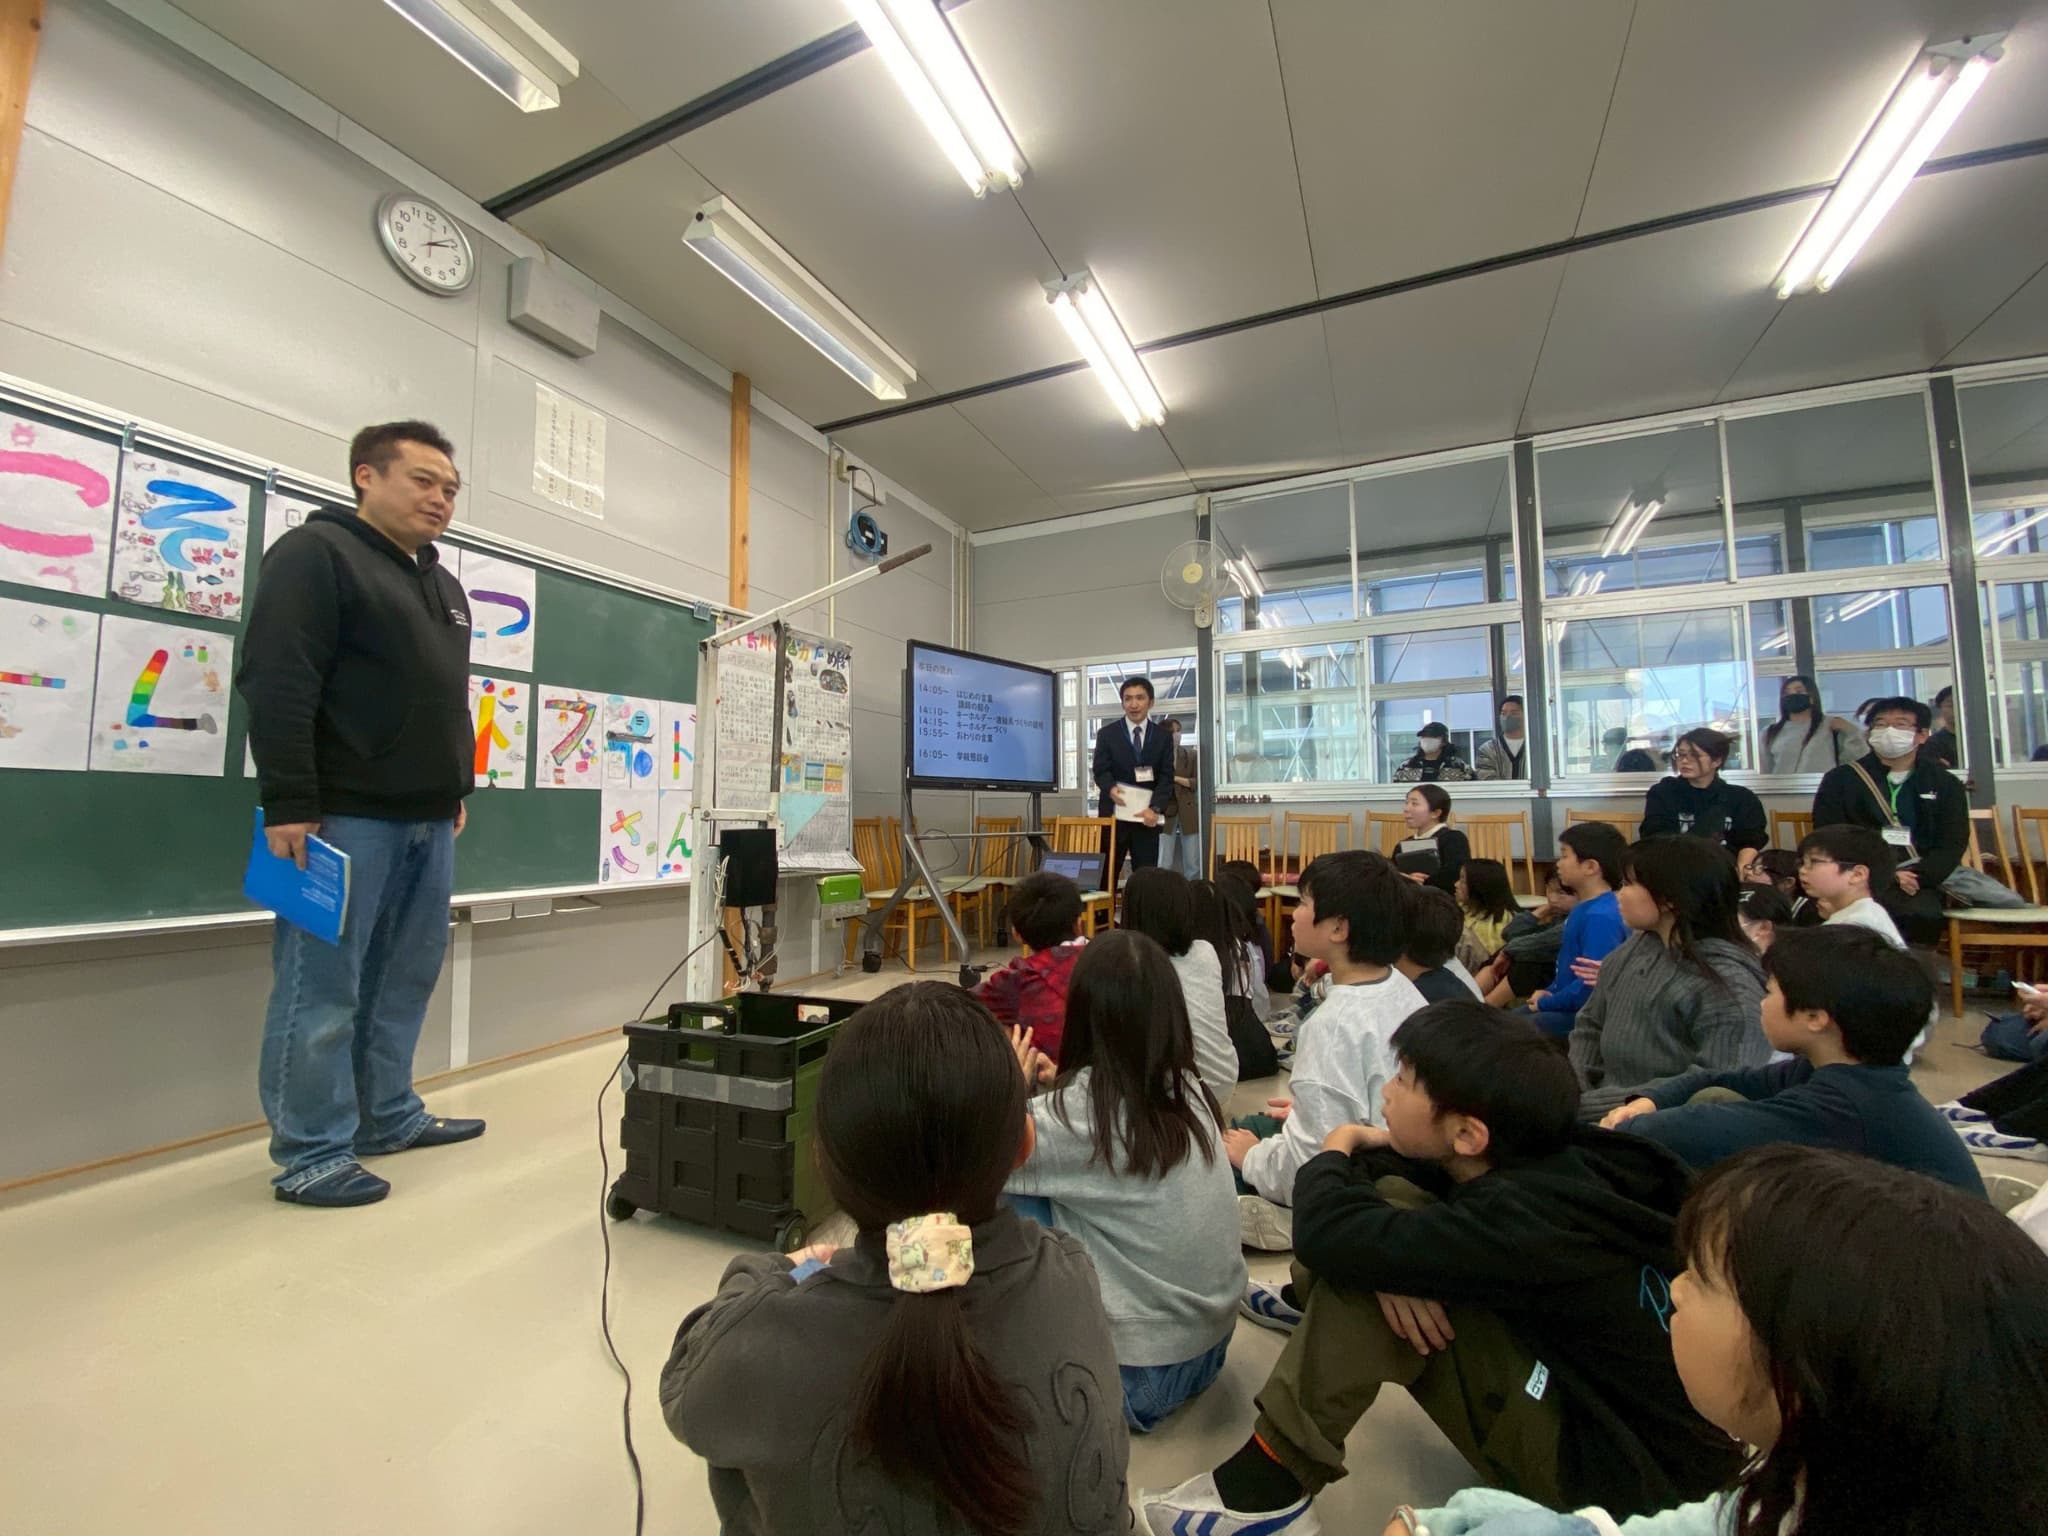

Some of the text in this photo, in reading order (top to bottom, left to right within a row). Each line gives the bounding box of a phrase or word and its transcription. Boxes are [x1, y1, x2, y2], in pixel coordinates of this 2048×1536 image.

[399, 210, 411, 222] 10
[412, 207, 421, 218] 11
[425, 211, 437, 224] 12
[395, 222, 404, 232] 9
[442, 225, 448, 235] 1
[398, 238, 407, 249] 8
[450, 239, 458, 251] 2
[409, 253, 417, 263] 7
[454, 255, 461, 266] 3
[423, 266, 432, 276] 6
[438, 270, 447, 281] 5
[449, 267, 456, 277] 4
